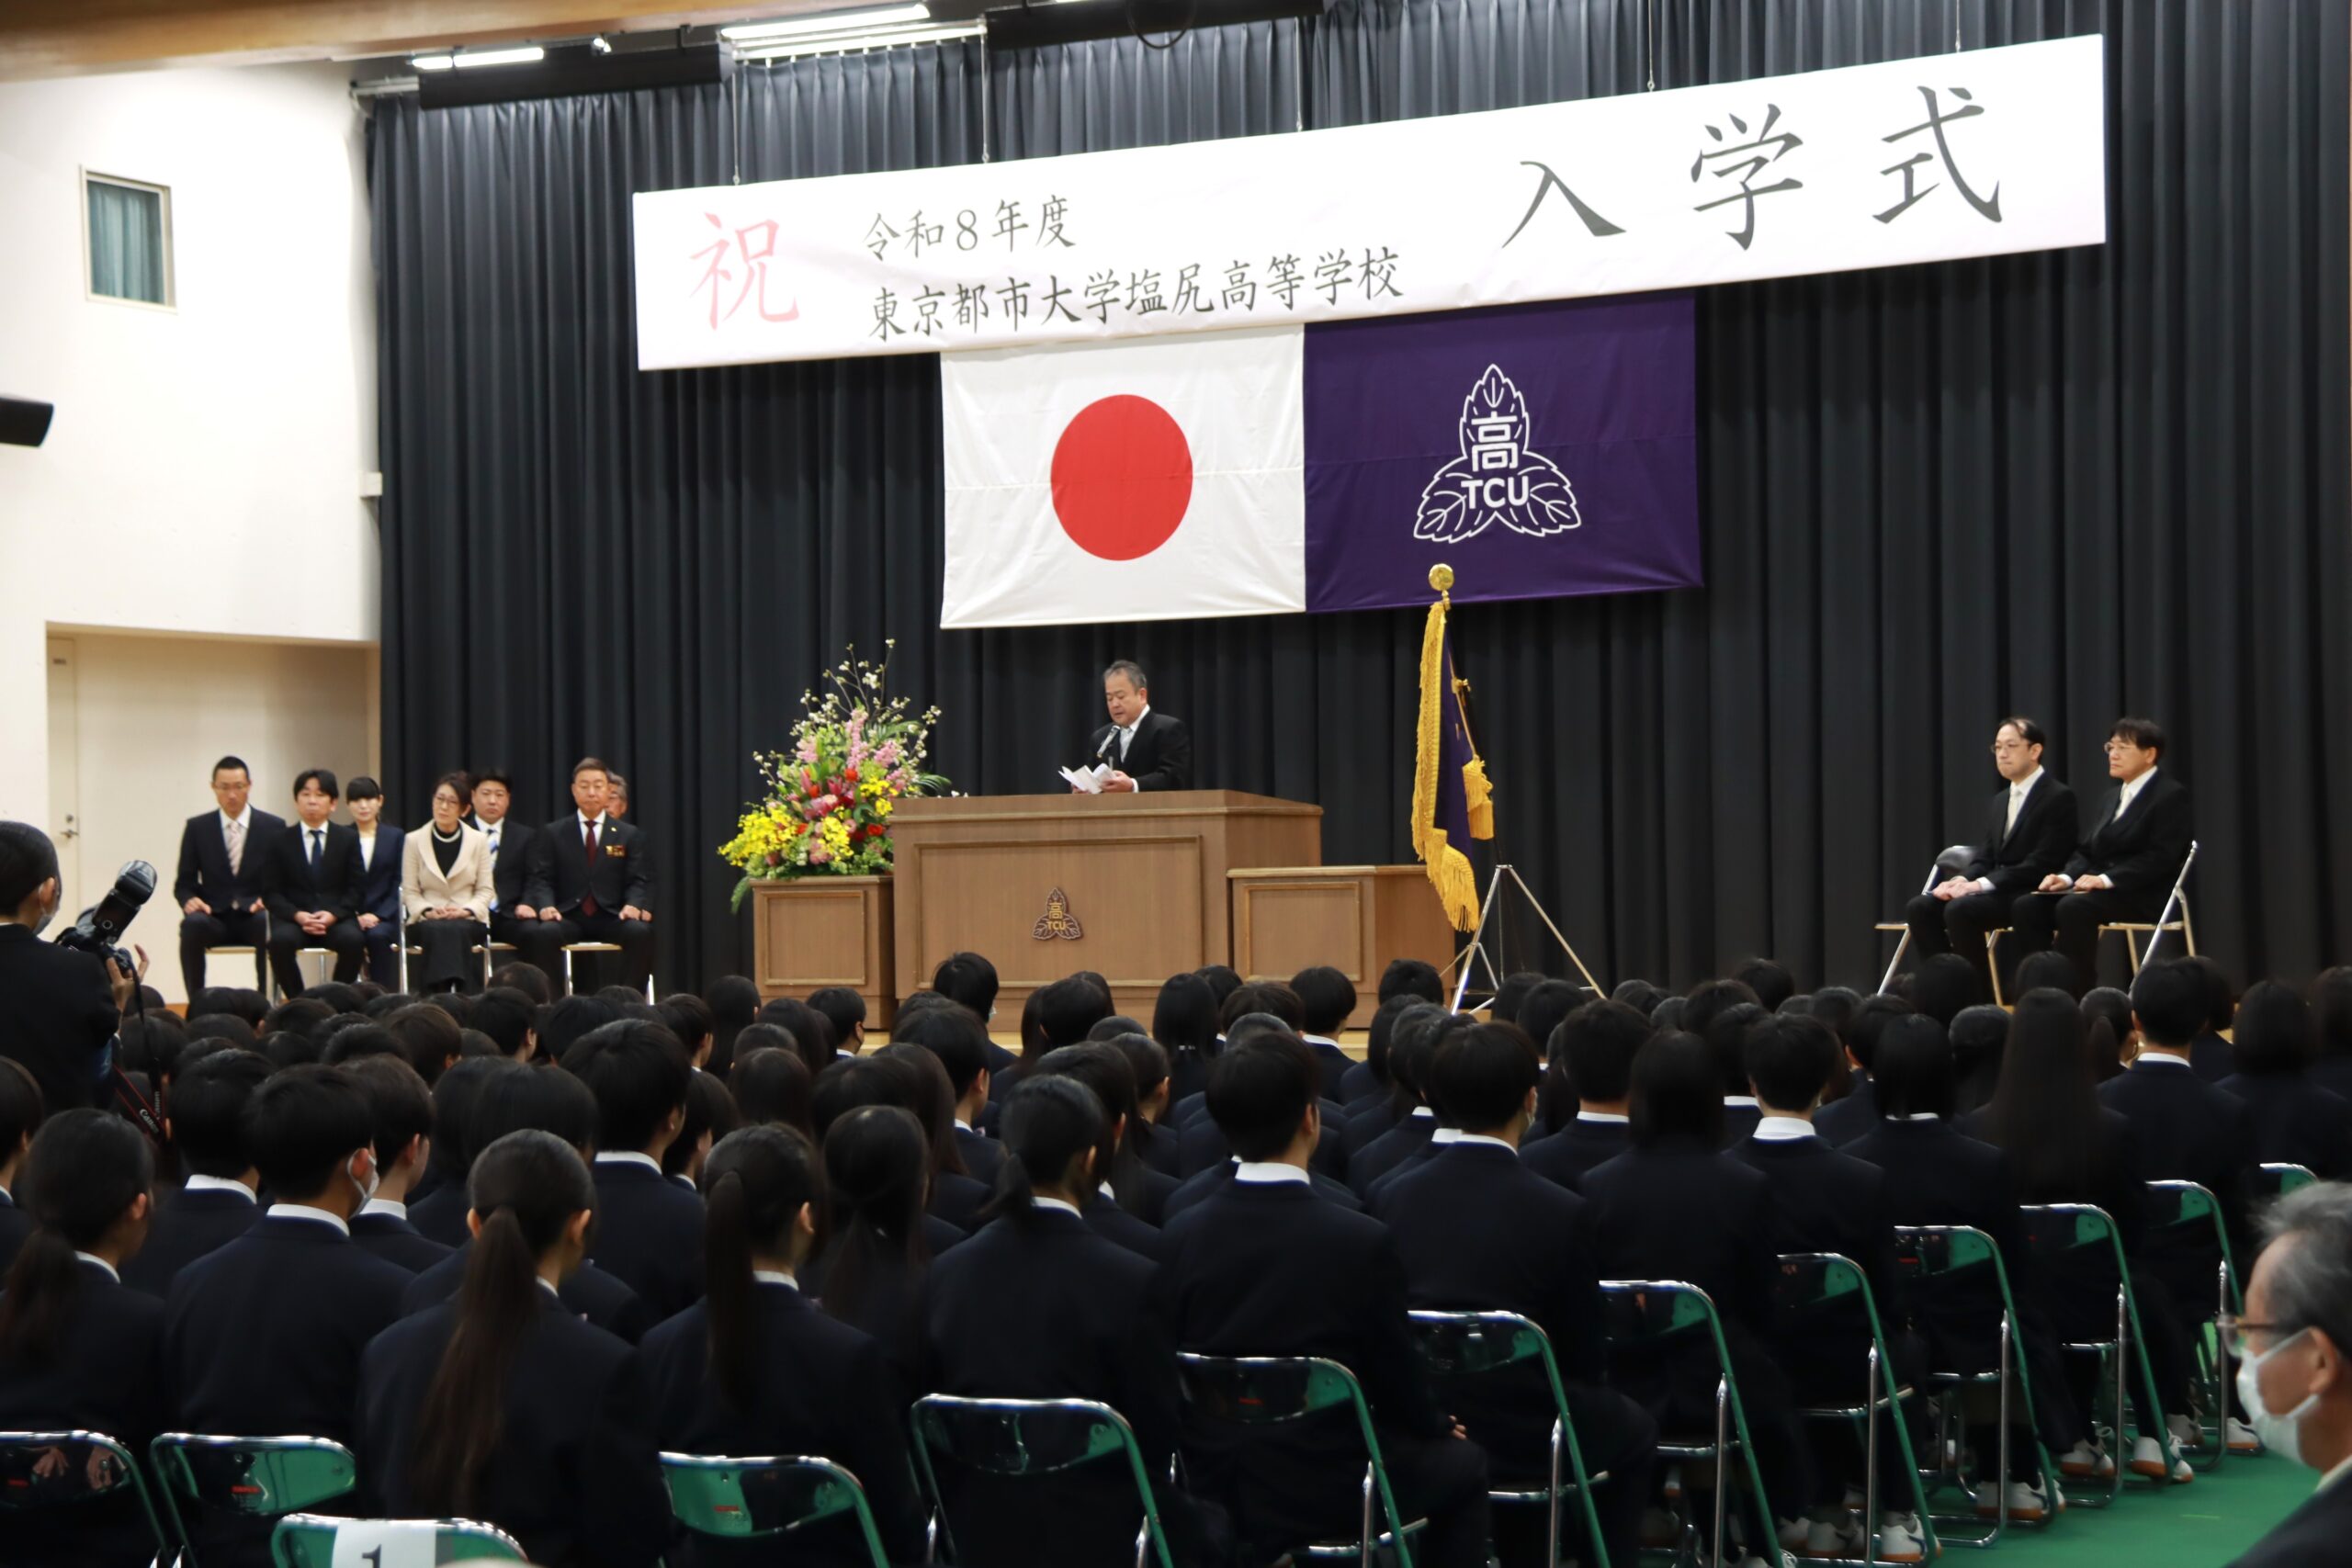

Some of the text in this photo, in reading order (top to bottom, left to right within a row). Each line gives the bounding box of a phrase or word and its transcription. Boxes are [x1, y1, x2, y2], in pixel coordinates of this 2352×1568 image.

[1501, 85, 2004, 251] 入学式
[865, 194, 1077, 262] 令和8年度
[689, 211, 799, 330] 祝
[866, 246, 1404, 343] 東京都市大学塩尻高等学校
[1471, 411, 1519, 471] 高
[1461, 476, 1529, 509] TCU
[1046, 920, 1066, 931] TCU
